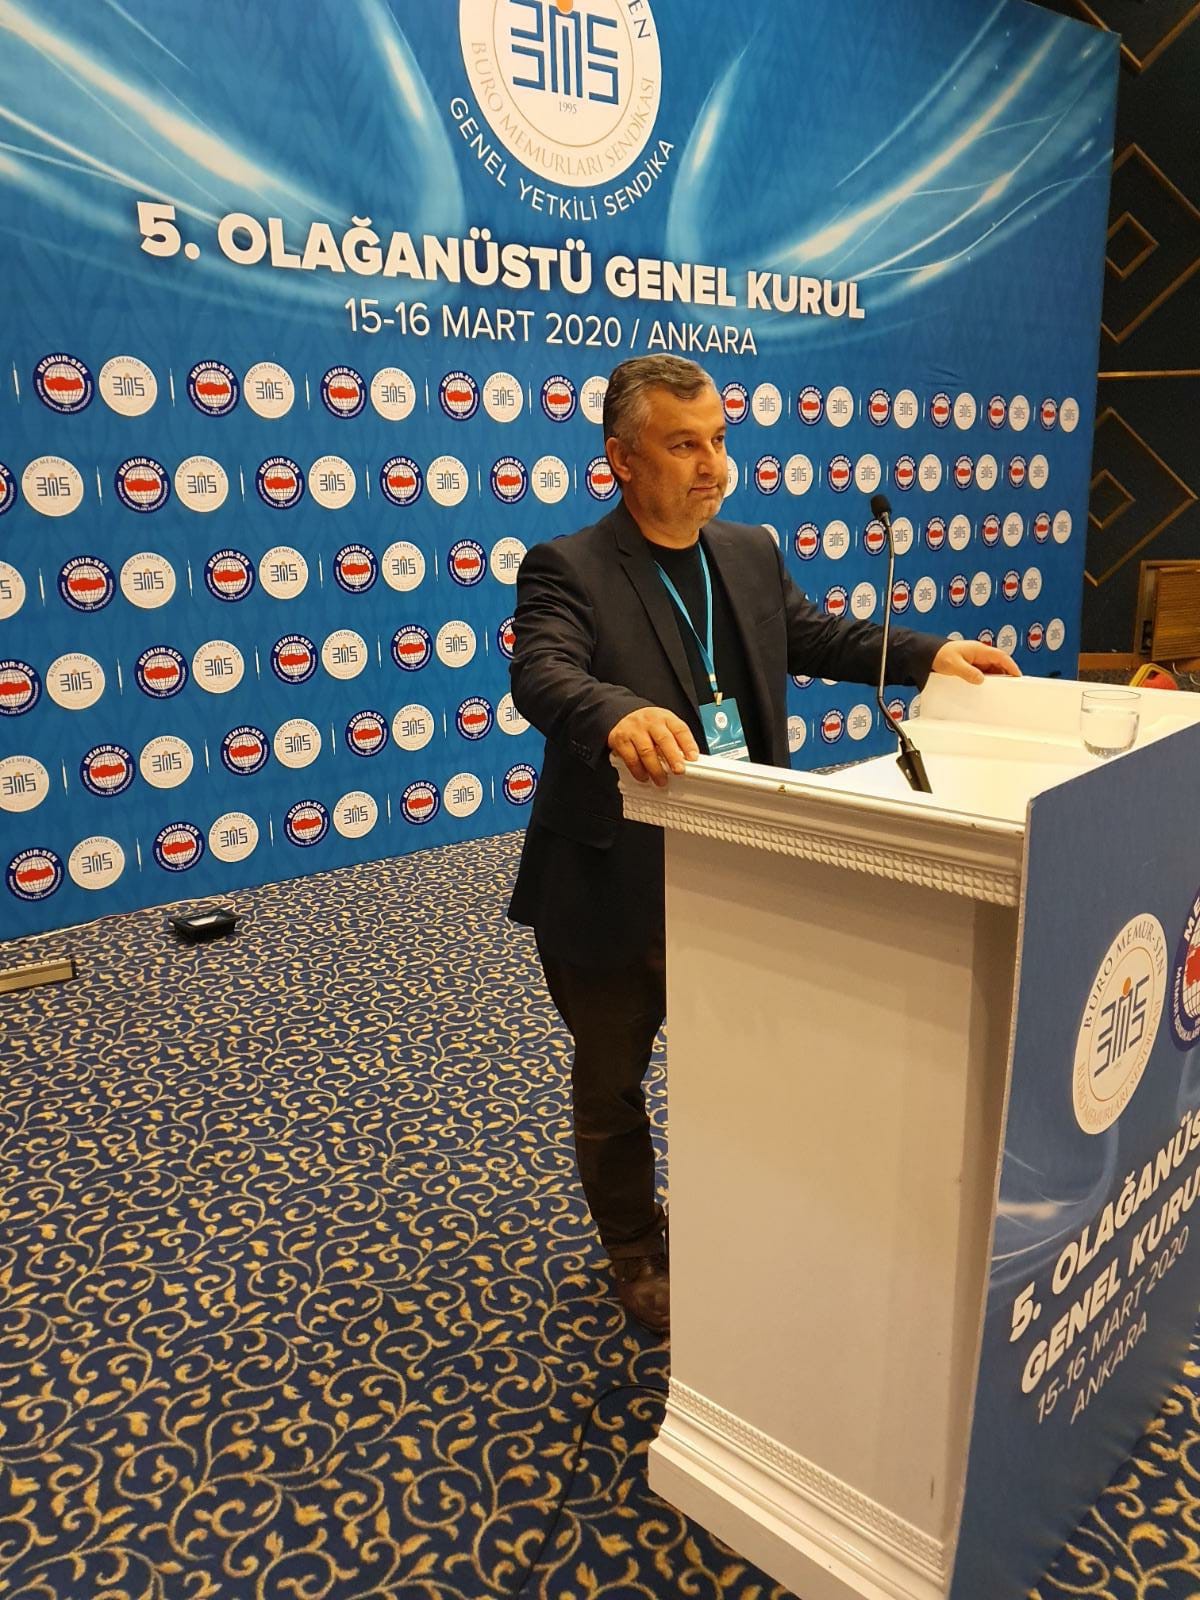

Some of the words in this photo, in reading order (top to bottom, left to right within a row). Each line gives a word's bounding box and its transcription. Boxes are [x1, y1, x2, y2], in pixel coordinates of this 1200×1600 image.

[450, 98, 507, 187] GENEL
[518, 178, 597, 220] YETKİLİ
[603, 139, 675, 216] SENDİKA
[500, 113, 602, 177] MEMURLARI
[607, 78, 655, 168] SENDİKASI
[558, 101, 577, 114] 1995
[137, 201, 200, 260] 5.
[218, 215, 592, 295] OLAĞANÜSTÜ
[604, 255, 736, 308] GENEL
[747, 270, 865, 319] KURUL
[344, 297, 430, 336] 15-16
[442, 304, 534, 342] MART
[545, 311, 622, 347] 2020
[647, 320, 758, 356] ANKARA
[1009, 1281, 1042, 1342] 5.
[1021, 1257, 1121, 1393] GENEL
[1128, 1166, 1200, 1276] KURU
[1038, 1346, 1086, 1424] 15-16
[1090, 1277, 1145, 1361] MART
[1146, 1225, 1189, 1294] 2020
[1070, 1311, 1147, 1425] ANKARA
